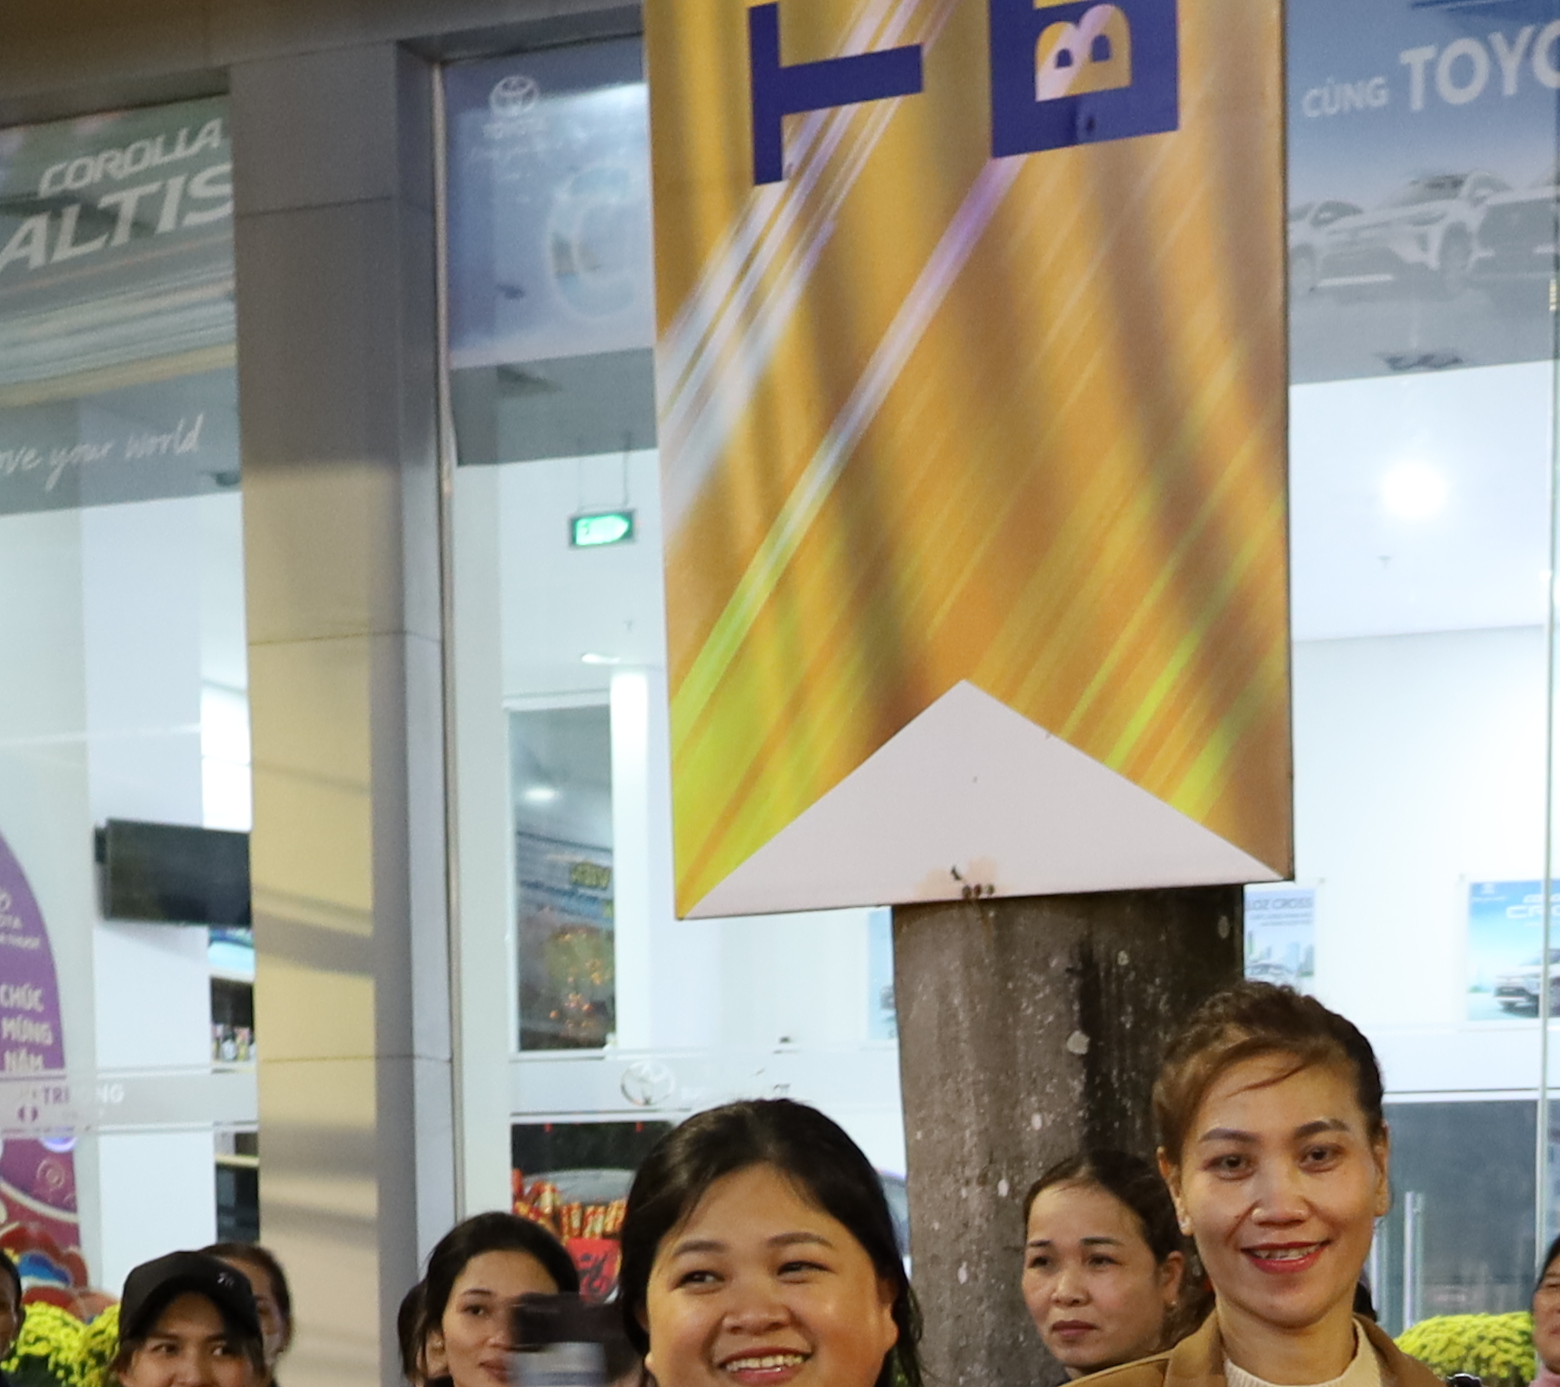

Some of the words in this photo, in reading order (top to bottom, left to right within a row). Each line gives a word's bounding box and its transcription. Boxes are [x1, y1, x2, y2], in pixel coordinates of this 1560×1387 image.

[1302, 71, 1390, 117] CÙNG
[38, 117, 223, 198] COROLLA
[44, 439, 117, 493] your
[125, 412, 205, 460] world
